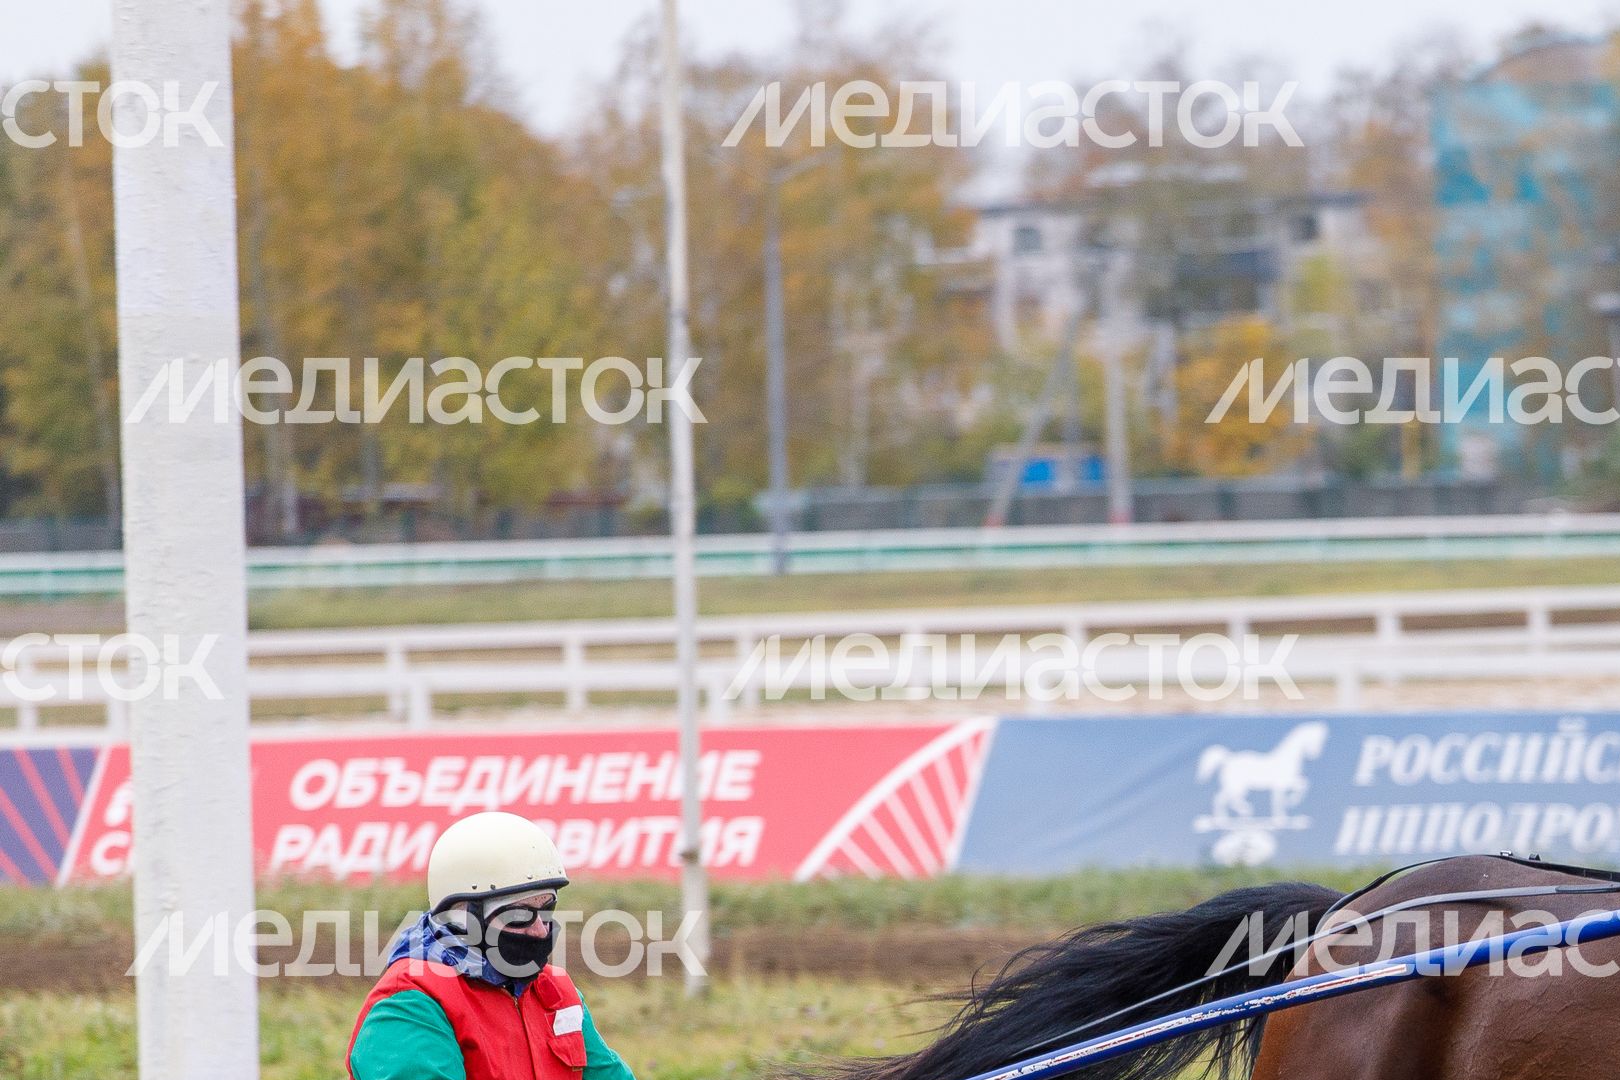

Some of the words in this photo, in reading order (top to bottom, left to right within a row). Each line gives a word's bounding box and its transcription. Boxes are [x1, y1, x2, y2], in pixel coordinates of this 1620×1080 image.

[290, 750, 762, 813] ОБЪЕДИНЕНИЕ
[268, 820, 438, 881] РАДИ
[533, 815, 765, 870] ВИТИЯ
